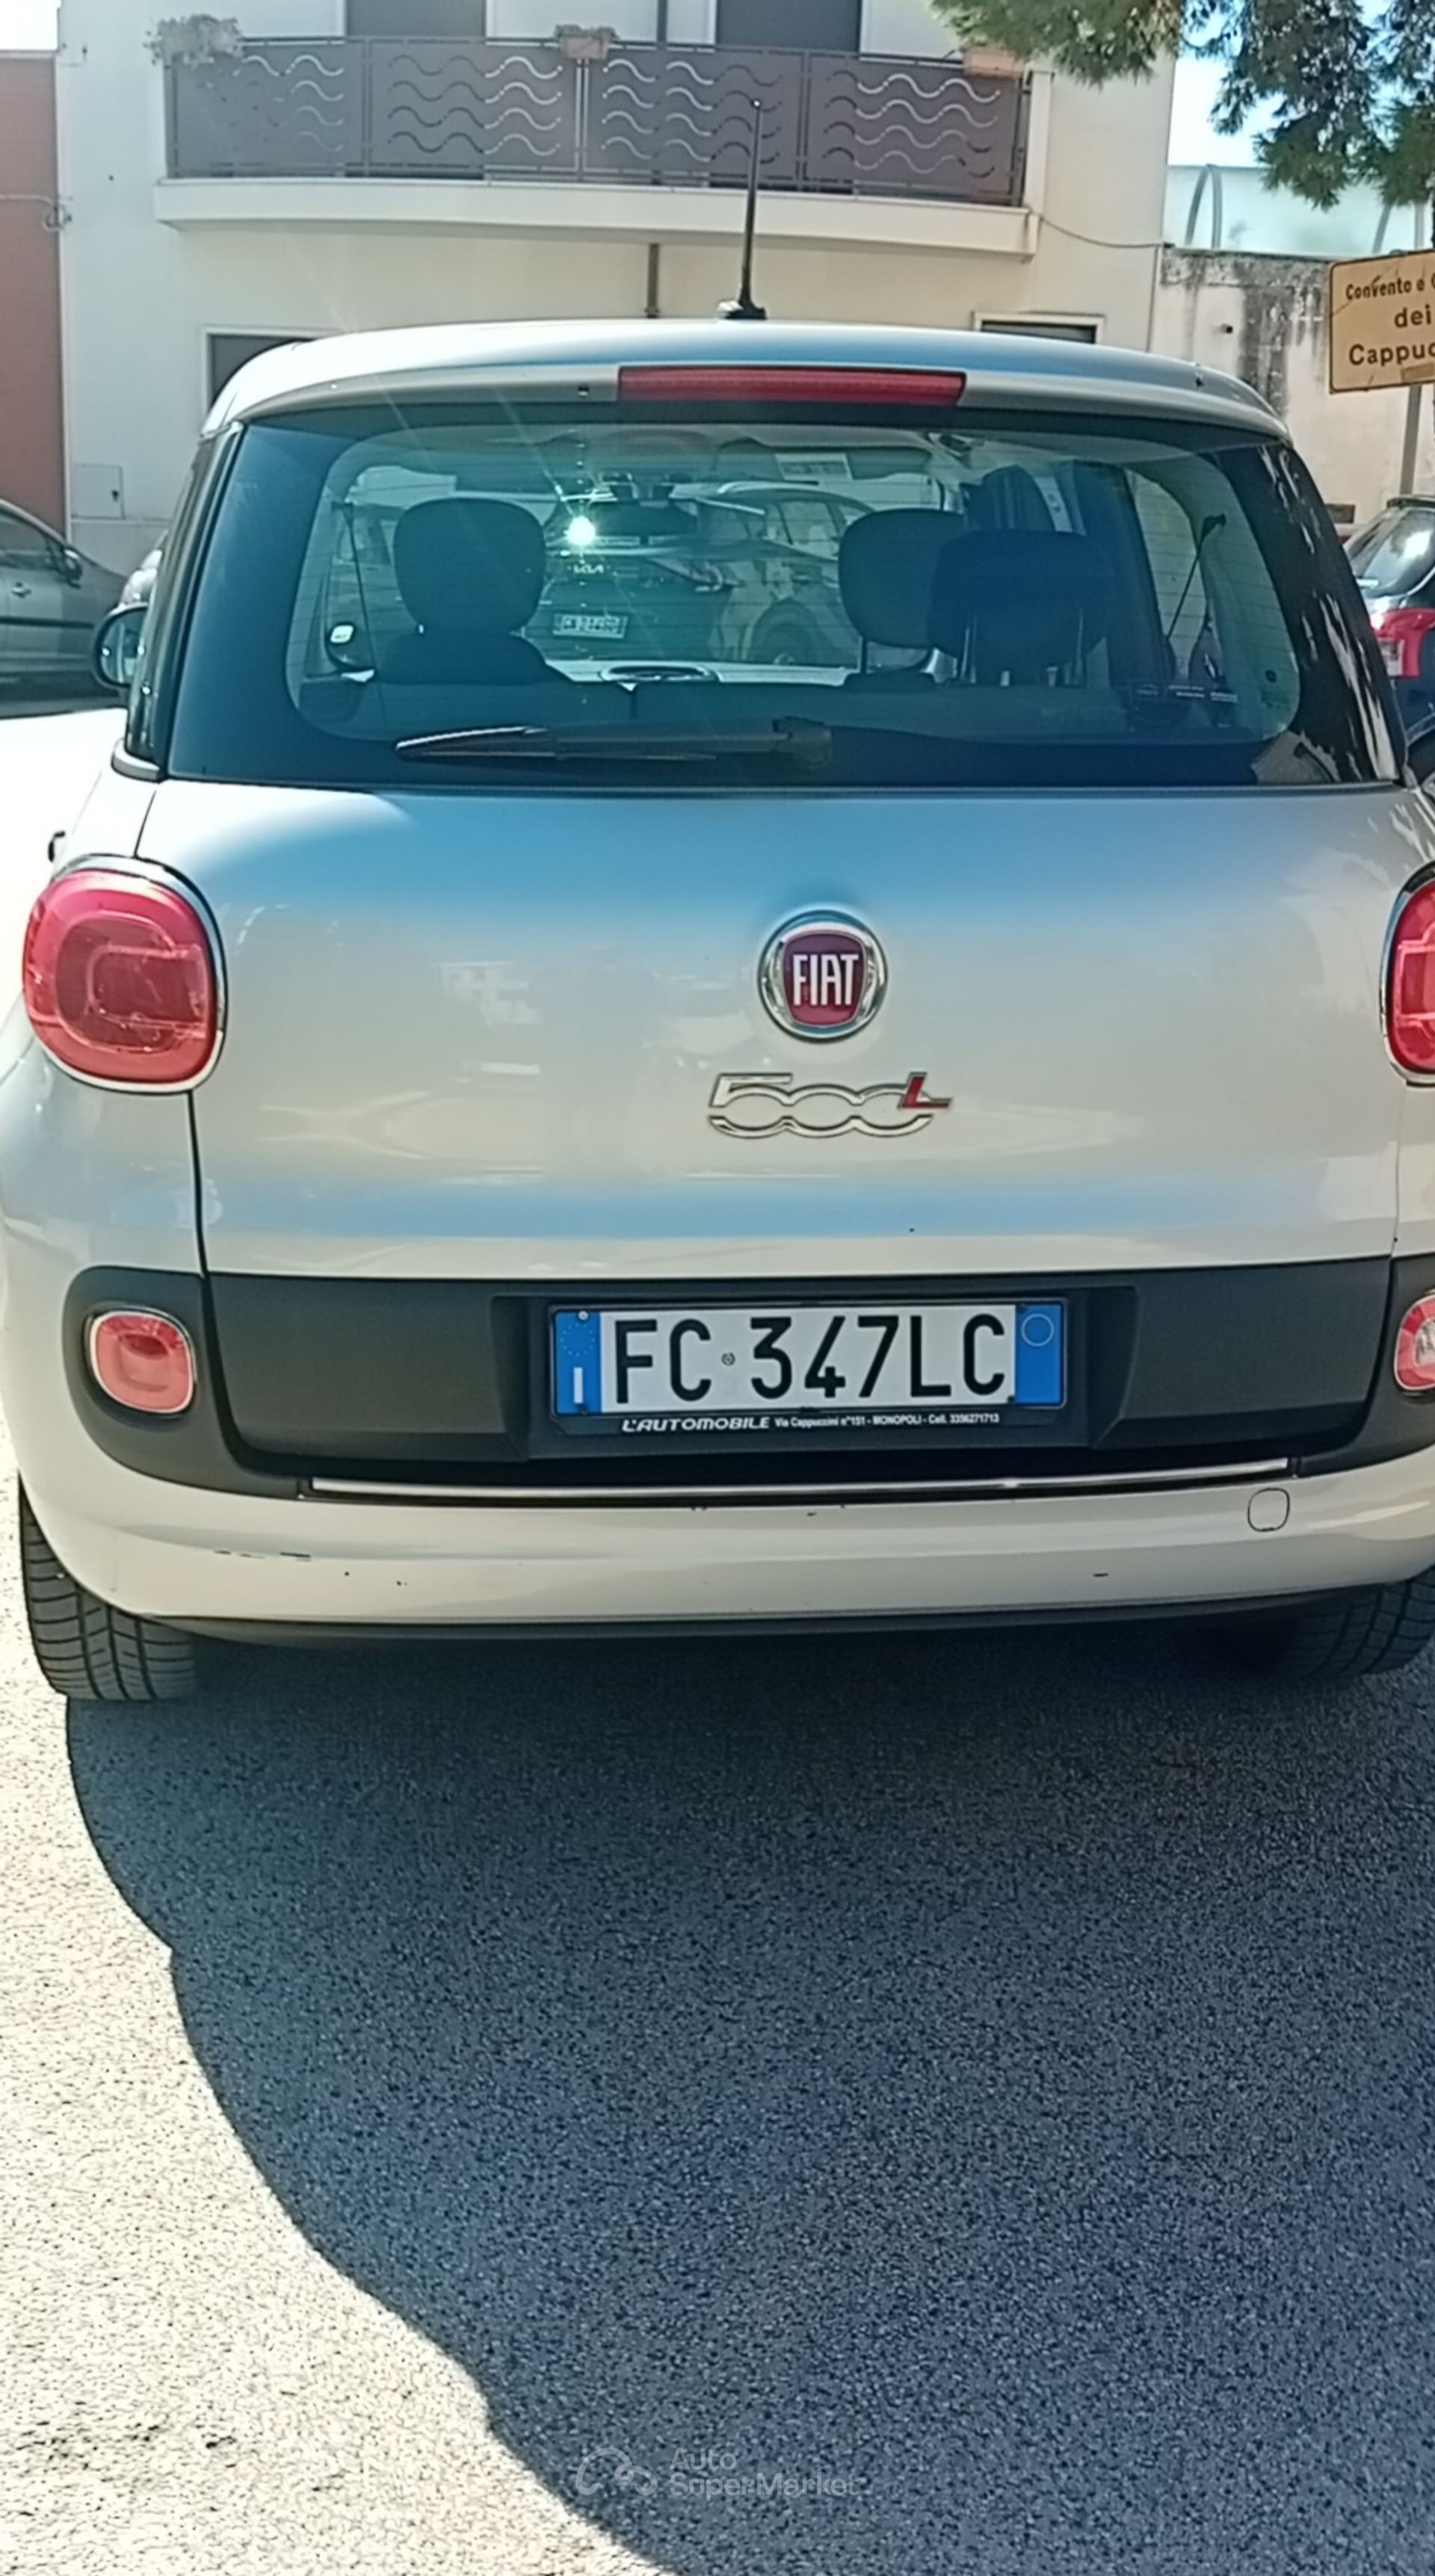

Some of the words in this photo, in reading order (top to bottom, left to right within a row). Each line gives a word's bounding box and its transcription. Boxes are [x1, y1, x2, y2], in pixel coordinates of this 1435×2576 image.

[1346, 277, 1412, 300] Convento
[1416, 279, 1425, 291] e
[1394, 303, 1431, 328] dei
[792, 954, 859, 1006] FIAT
[621, 1417, 770, 1433] L'AUTOMOBILE
[774, 1417, 789, 1428] Via
[791, 1416, 839, 1429] Cappuccini
[873, 1414, 922, 1426] MONOPOLI
